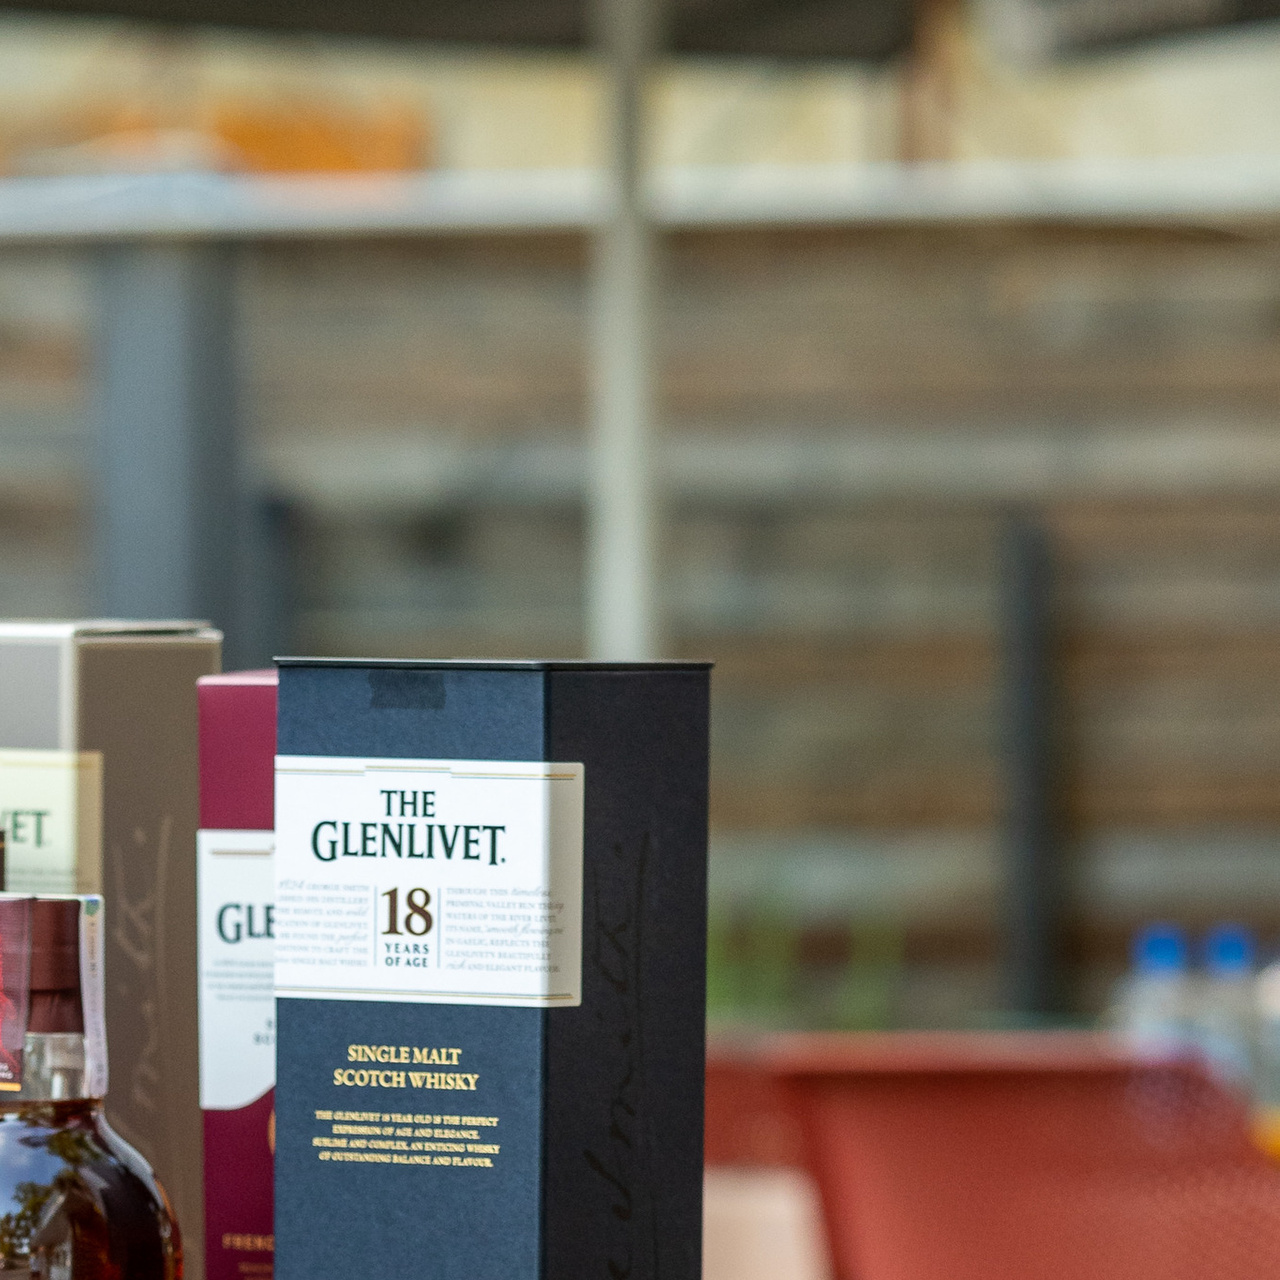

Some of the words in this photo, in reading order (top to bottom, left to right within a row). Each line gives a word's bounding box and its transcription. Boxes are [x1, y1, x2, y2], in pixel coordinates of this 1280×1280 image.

[380, 789, 436, 818] THE
[381, 887, 433, 937] 18
[385, 943, 429, 955] YEARS
[385, 956, 400, 967] OF
[405, 957, 428, 968] AGE
[347, 1044, 410, 1063] SINGLE
[413, 1048, 462, 1065] MALT
[333, 1069, 406, 1088] SCOTCH
[408, 1072, 480, 1091] WHISKY
